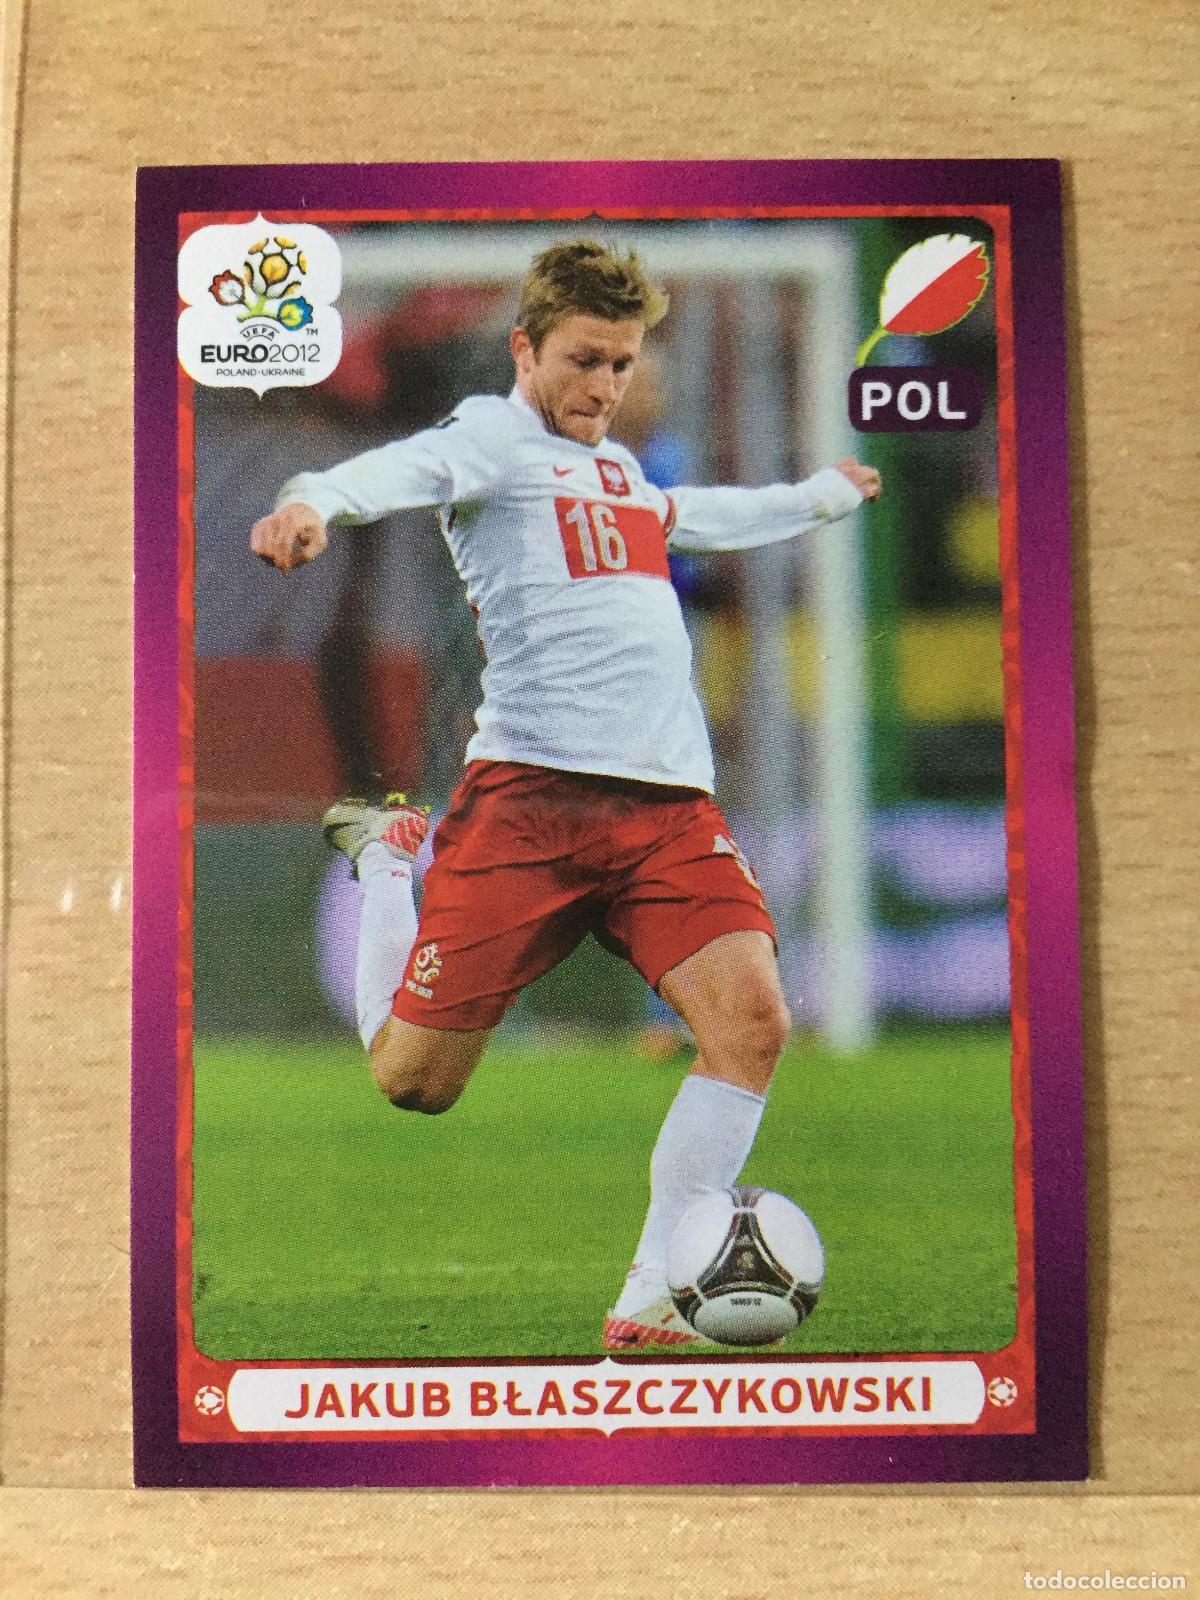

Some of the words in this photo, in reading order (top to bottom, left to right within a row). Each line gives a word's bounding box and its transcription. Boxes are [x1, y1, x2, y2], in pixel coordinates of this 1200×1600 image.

[242, 327, 276, 339] UEFA
[861, 381, 967, 421] POL
[566, 500, 628, 572] 16
[284, 1382, 451, 1419] JAKUB
[469, 1376, 932, 1417] BŁASZCZYKOWSKI
